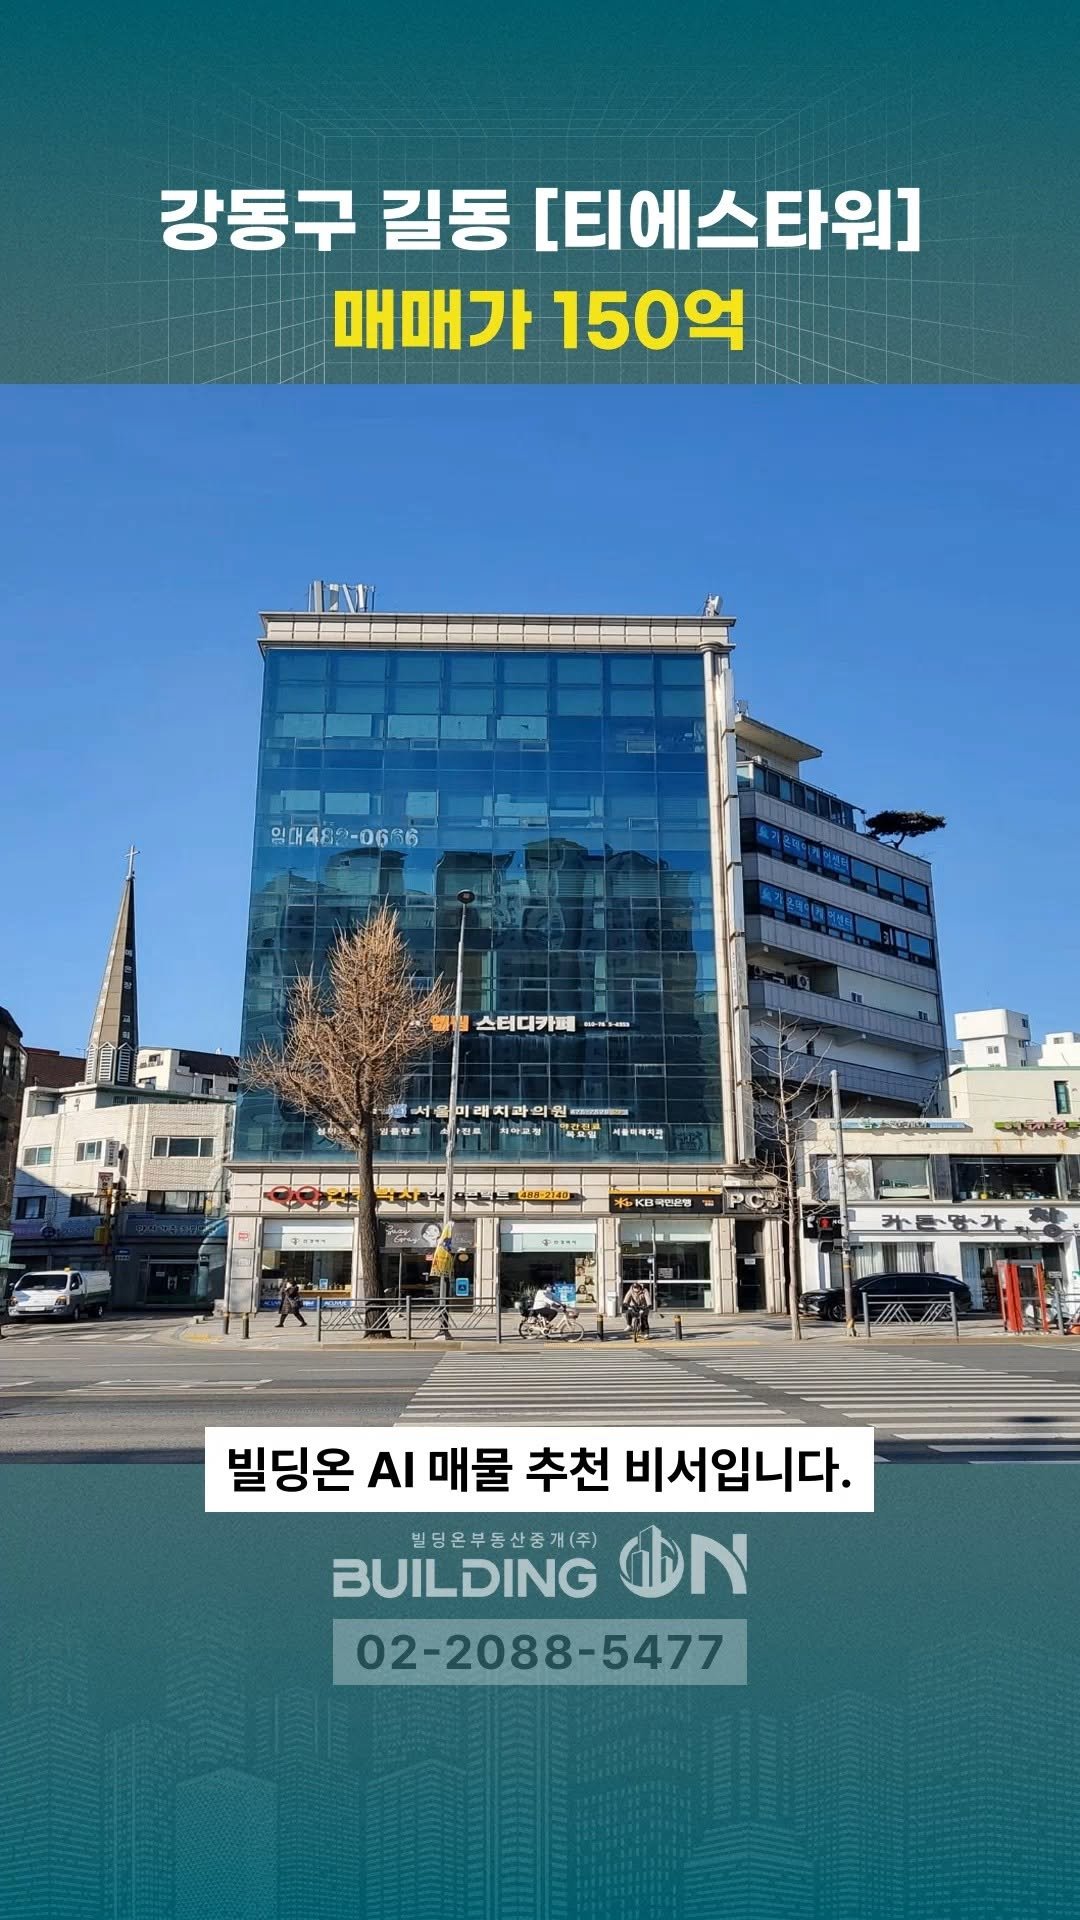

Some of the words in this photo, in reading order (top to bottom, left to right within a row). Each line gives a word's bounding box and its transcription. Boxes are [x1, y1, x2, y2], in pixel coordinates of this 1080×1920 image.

[476, 1015, 576, 1032] 스터디카페
[414, 1104, 567, 1119] 서울미래치과의원
[499, 1126, 542, 1137] 치아교정
[612, 1127, 664, 1137] 서울미래치과
[565, 1130, 598, 1139] 목요일
[519, 1191, 569, 1200] 488-2140
